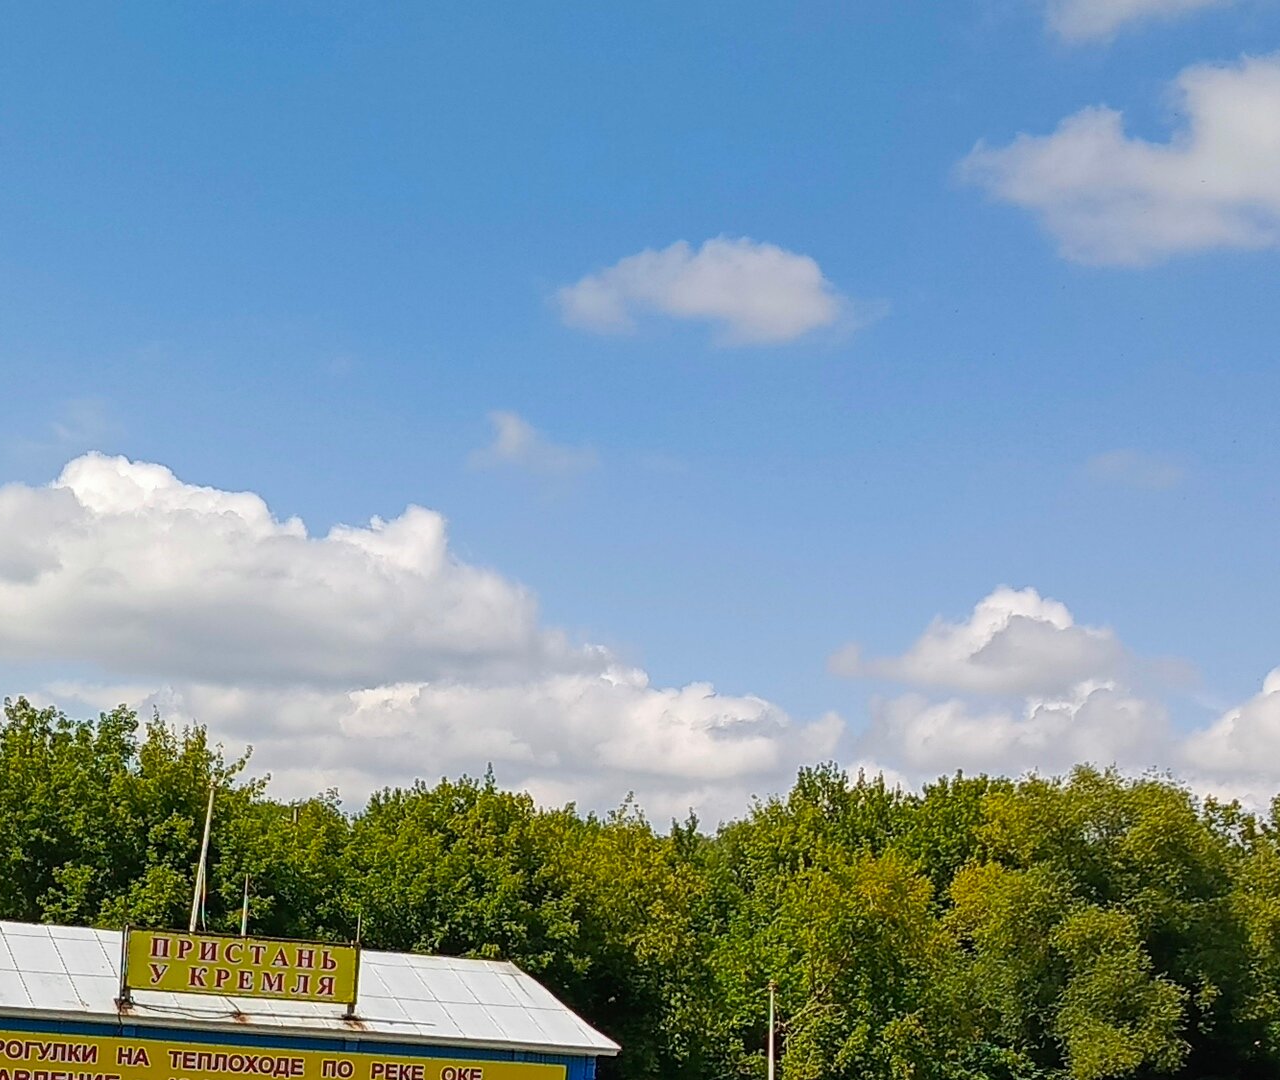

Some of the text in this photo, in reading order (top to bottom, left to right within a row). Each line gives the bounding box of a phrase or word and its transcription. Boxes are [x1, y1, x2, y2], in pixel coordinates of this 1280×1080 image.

[150, 937, 337, 970] ПРИСТАНЬ
[148, 963, 335, 996] У КРЕМЛЯ
[117, 1046, 150, 1067] НА
[168, 1050, 304, 1078] ТЕПЛОХОДЕ
[321, 1060, 354, 1078] ПО
